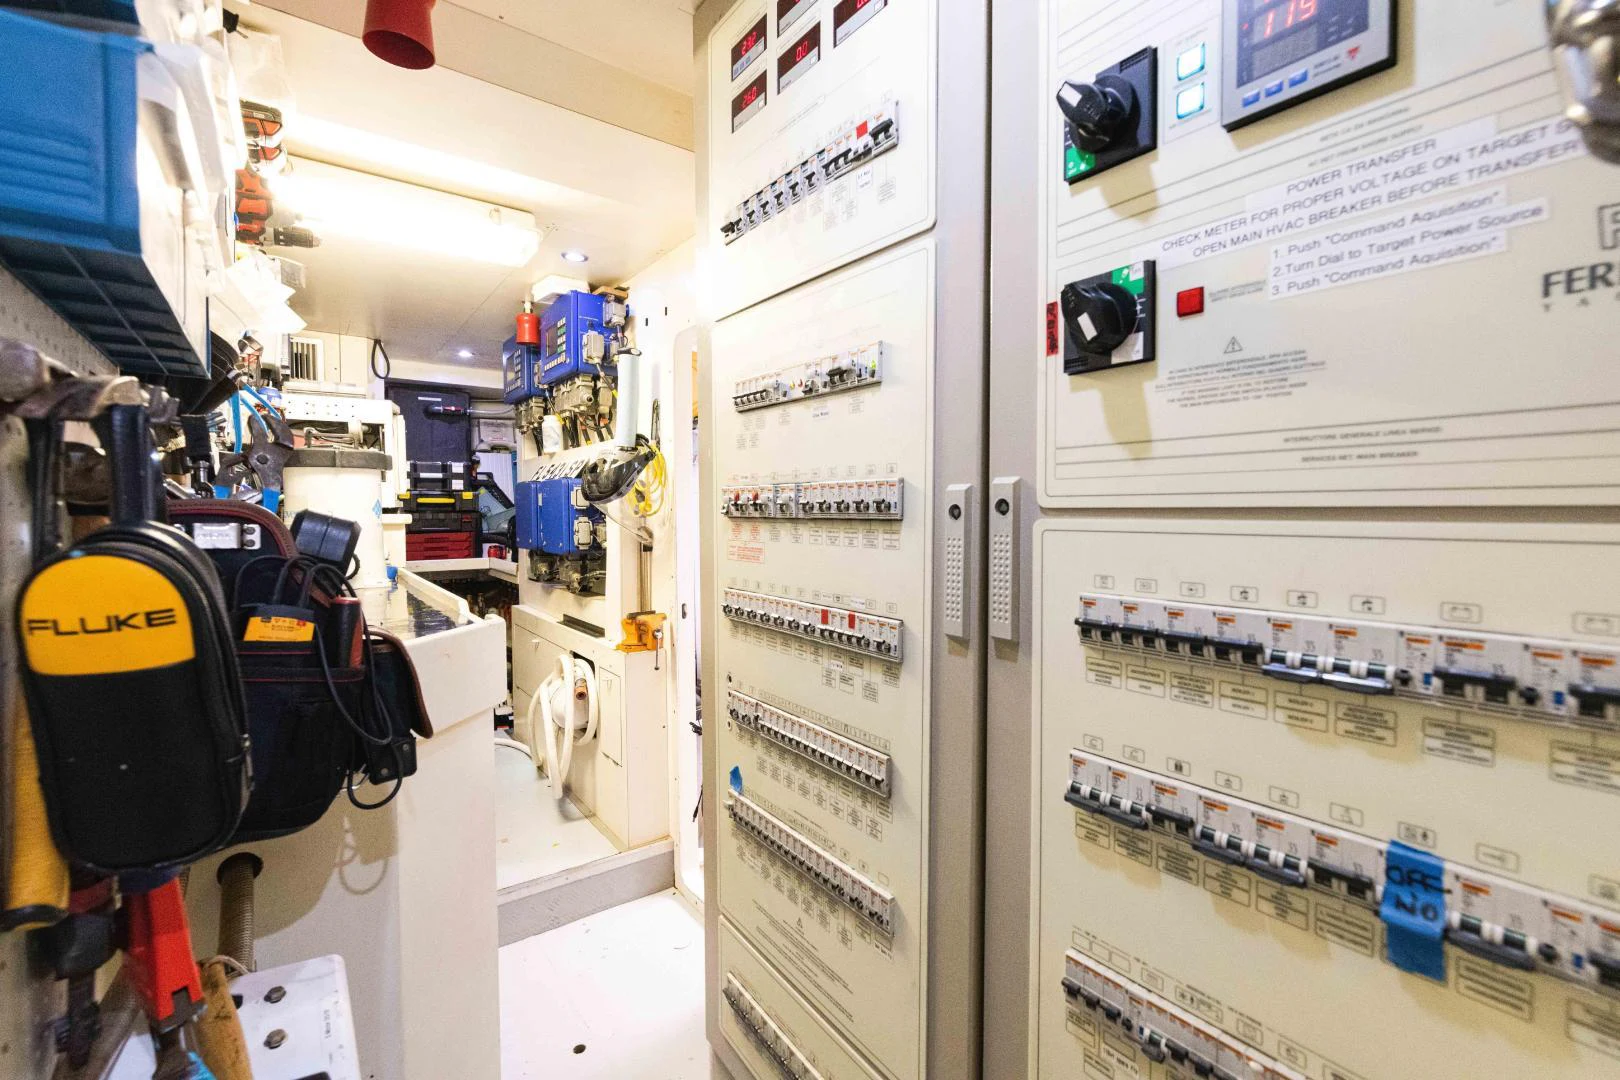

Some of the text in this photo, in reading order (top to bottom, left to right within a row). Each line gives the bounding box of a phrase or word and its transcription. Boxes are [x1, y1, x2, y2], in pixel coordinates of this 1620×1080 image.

[1287, 169, 1342, 195] POWER
[1346, 138, 1437, 176] TRANSFER
[1162, 232, 1201, 251] CHECK
[1204, 219, 1247, 238] METER
[1251, 207, 1279, 226] FOR
[1282, 186, 1344, 216] PROPER
[1349, 161, 1428, 194] VOLTAGE
[1432, 151, 1460, 170] ON
[1466, 125, 1550, 159] TARGET
[1193, 139, 1579, 258] OPEN MAIN HVAC BREAKER BEFORE TRANSFER
[1288, 240, 1321, 255] Push
[1319, 250, 1344, 266] Dial
[1348, 248, 1362, 260] to
[1367, 235, 1415, 255] Target
[1420, 221, 1472, 243] Power
[1477, 205, 1544, 230] Source
[1287, 278, 1321, 293] Push
[1542, 261, 1620, 299] FER
[27, 608, 178, 637] FLUKE
[1385, 865, 1453, 894] OFF
